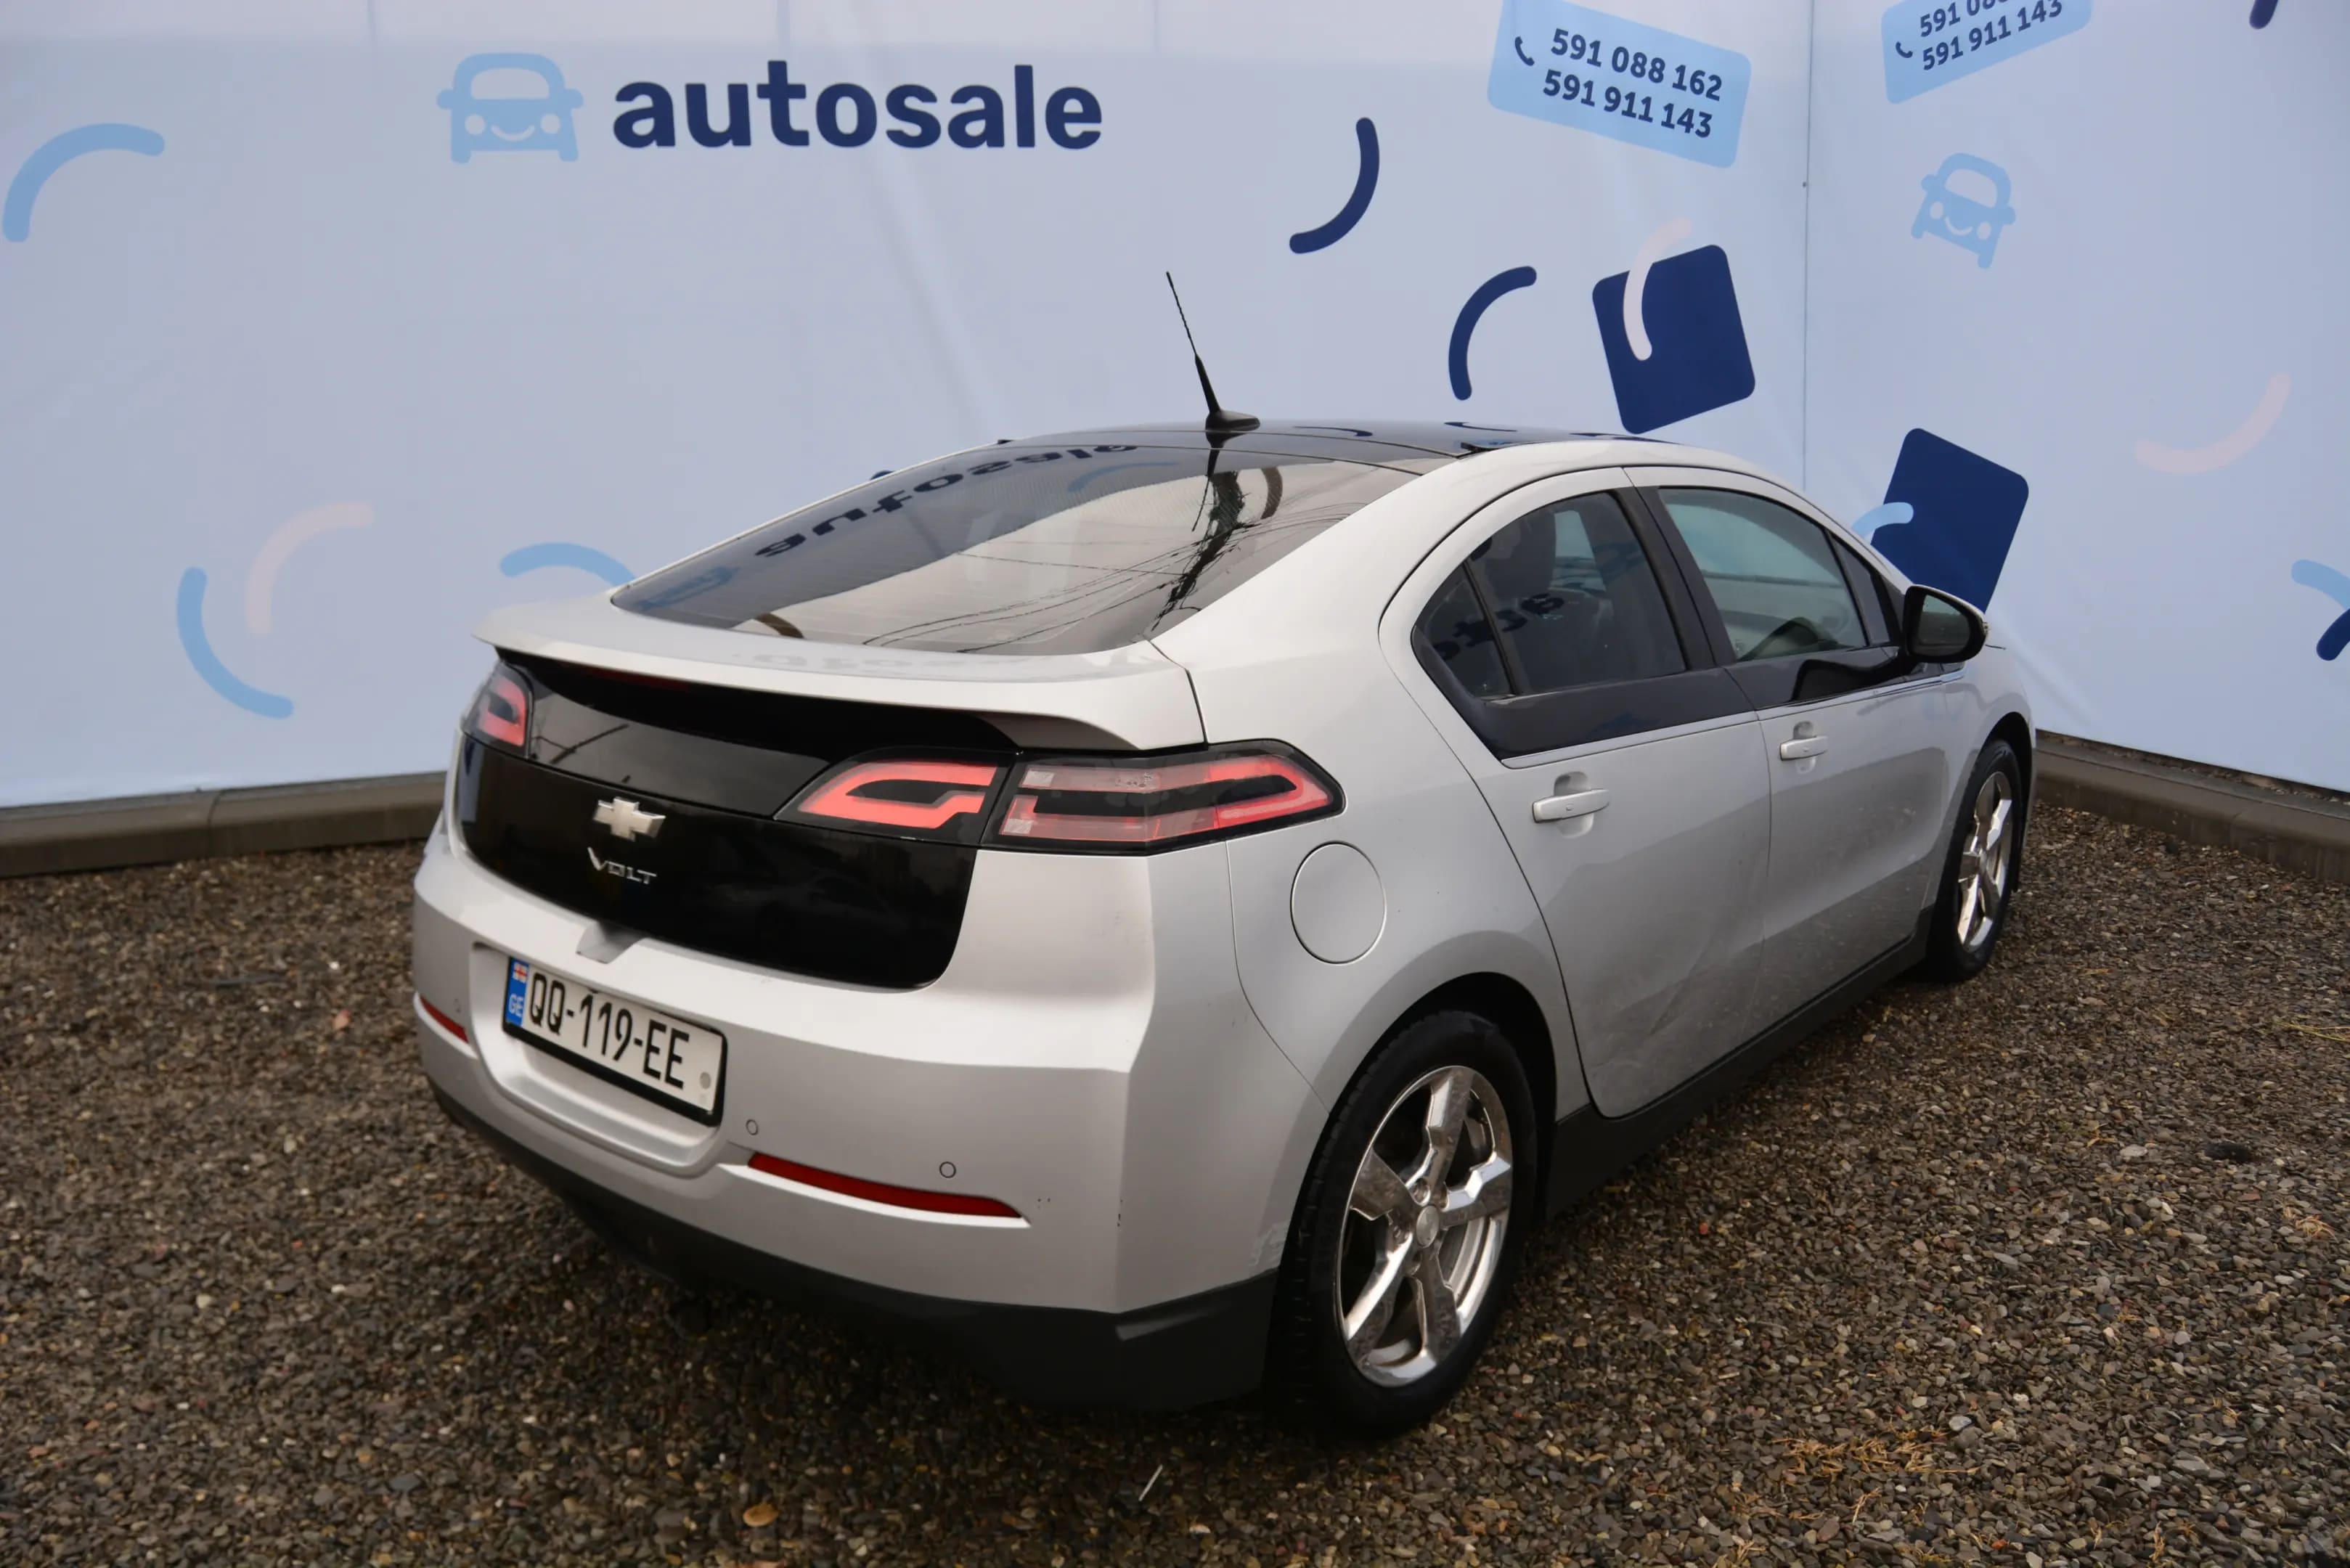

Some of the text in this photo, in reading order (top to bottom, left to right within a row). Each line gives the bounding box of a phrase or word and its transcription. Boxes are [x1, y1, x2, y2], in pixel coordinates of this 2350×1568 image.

[1920, 2, 1961, 37] 591
[1922, 36, 1963, 70] 591
[1968, 15, 2011, 52] 911
[2017, 0, 2063, 31] 143
[1551, 28, 1722, 102] 591 088 162
[613, 60, 1102, 150] autosale
[1543, 69, 1713, 138] 591 911 143
[587, 846, 656, 884] VOLT
[508, 994, 523, 1017] GE
[529, 972, 690, 1090] QQ-119-EE
